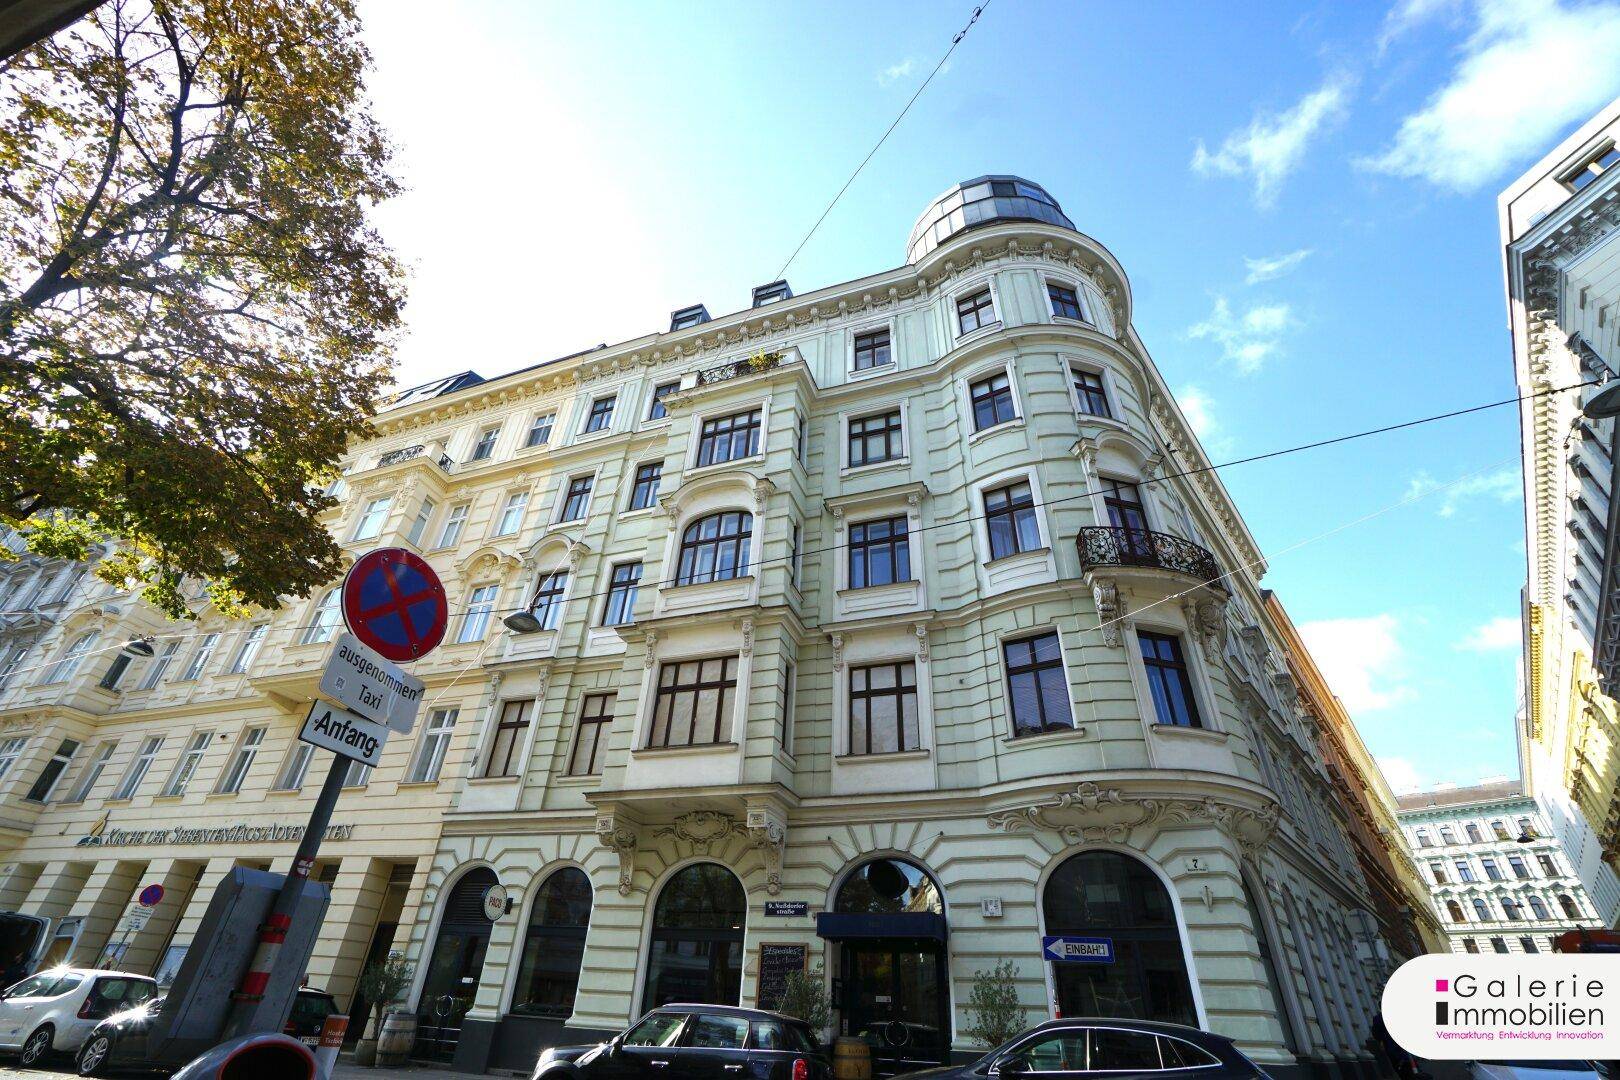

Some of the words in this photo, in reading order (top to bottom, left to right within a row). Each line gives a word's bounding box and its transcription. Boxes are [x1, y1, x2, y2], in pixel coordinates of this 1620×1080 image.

[339, 644, 418, 702] ausgenommen
[358, 684, 383, 711] Taxi
[314, 711, 378, 758] Anfang
